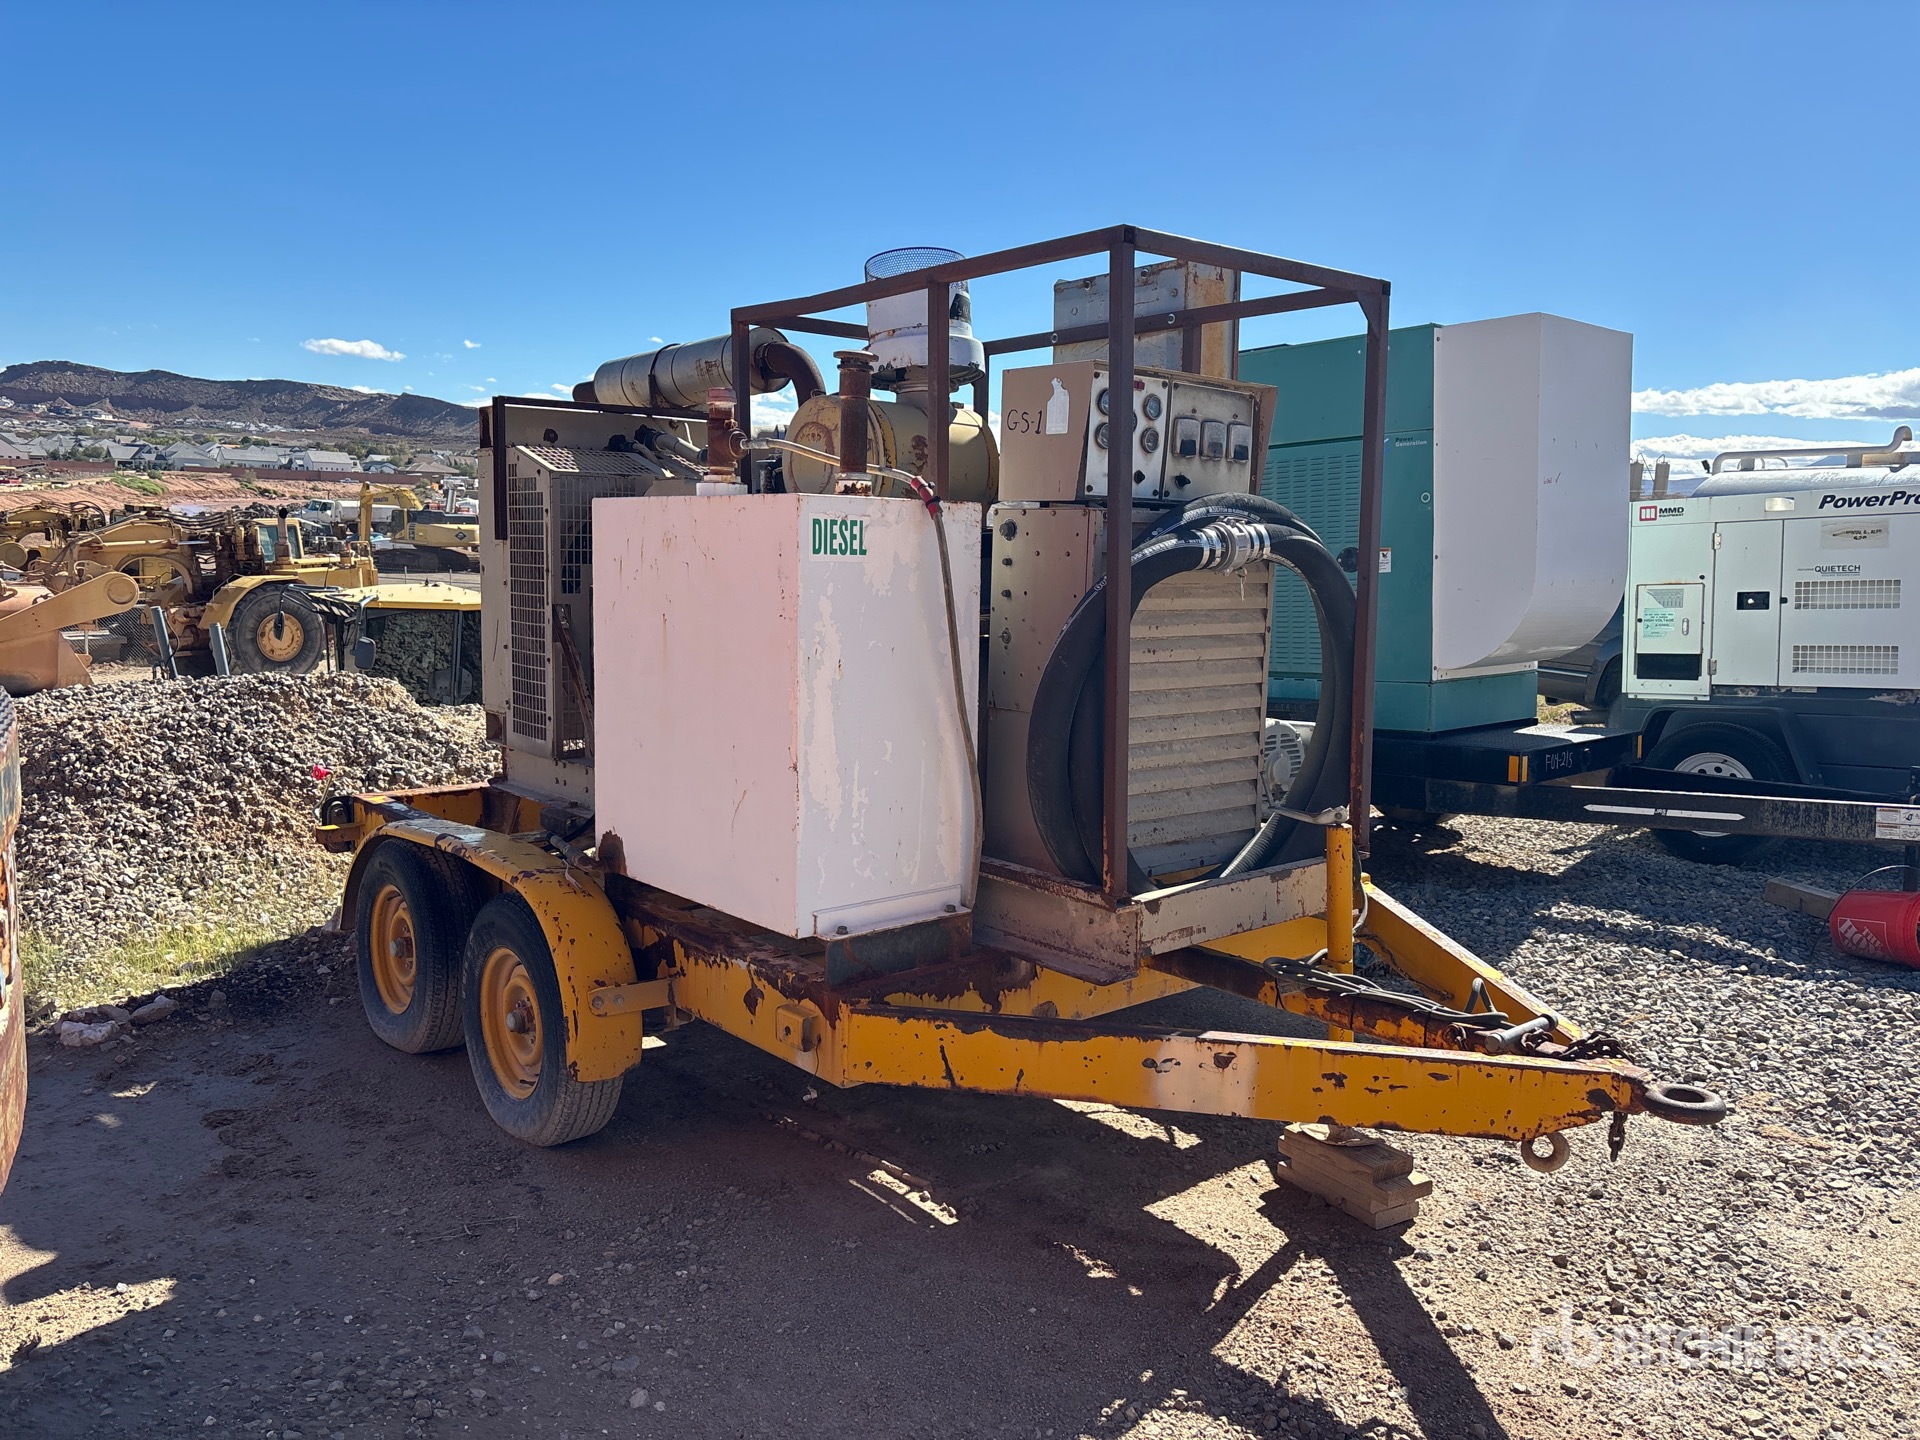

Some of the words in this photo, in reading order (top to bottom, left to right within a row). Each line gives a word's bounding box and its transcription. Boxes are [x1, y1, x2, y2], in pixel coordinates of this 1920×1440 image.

[1006, 408, 1043, 435] GS-1
[1395, 440, 1428, 448] Generation
[1658, 506, 1685, 515] MMD
[812, 518, 867, 556] DIESEL
[1814, 564, 1861, 573] QUIETECH
[1861, 926, 1884, 950] THE
